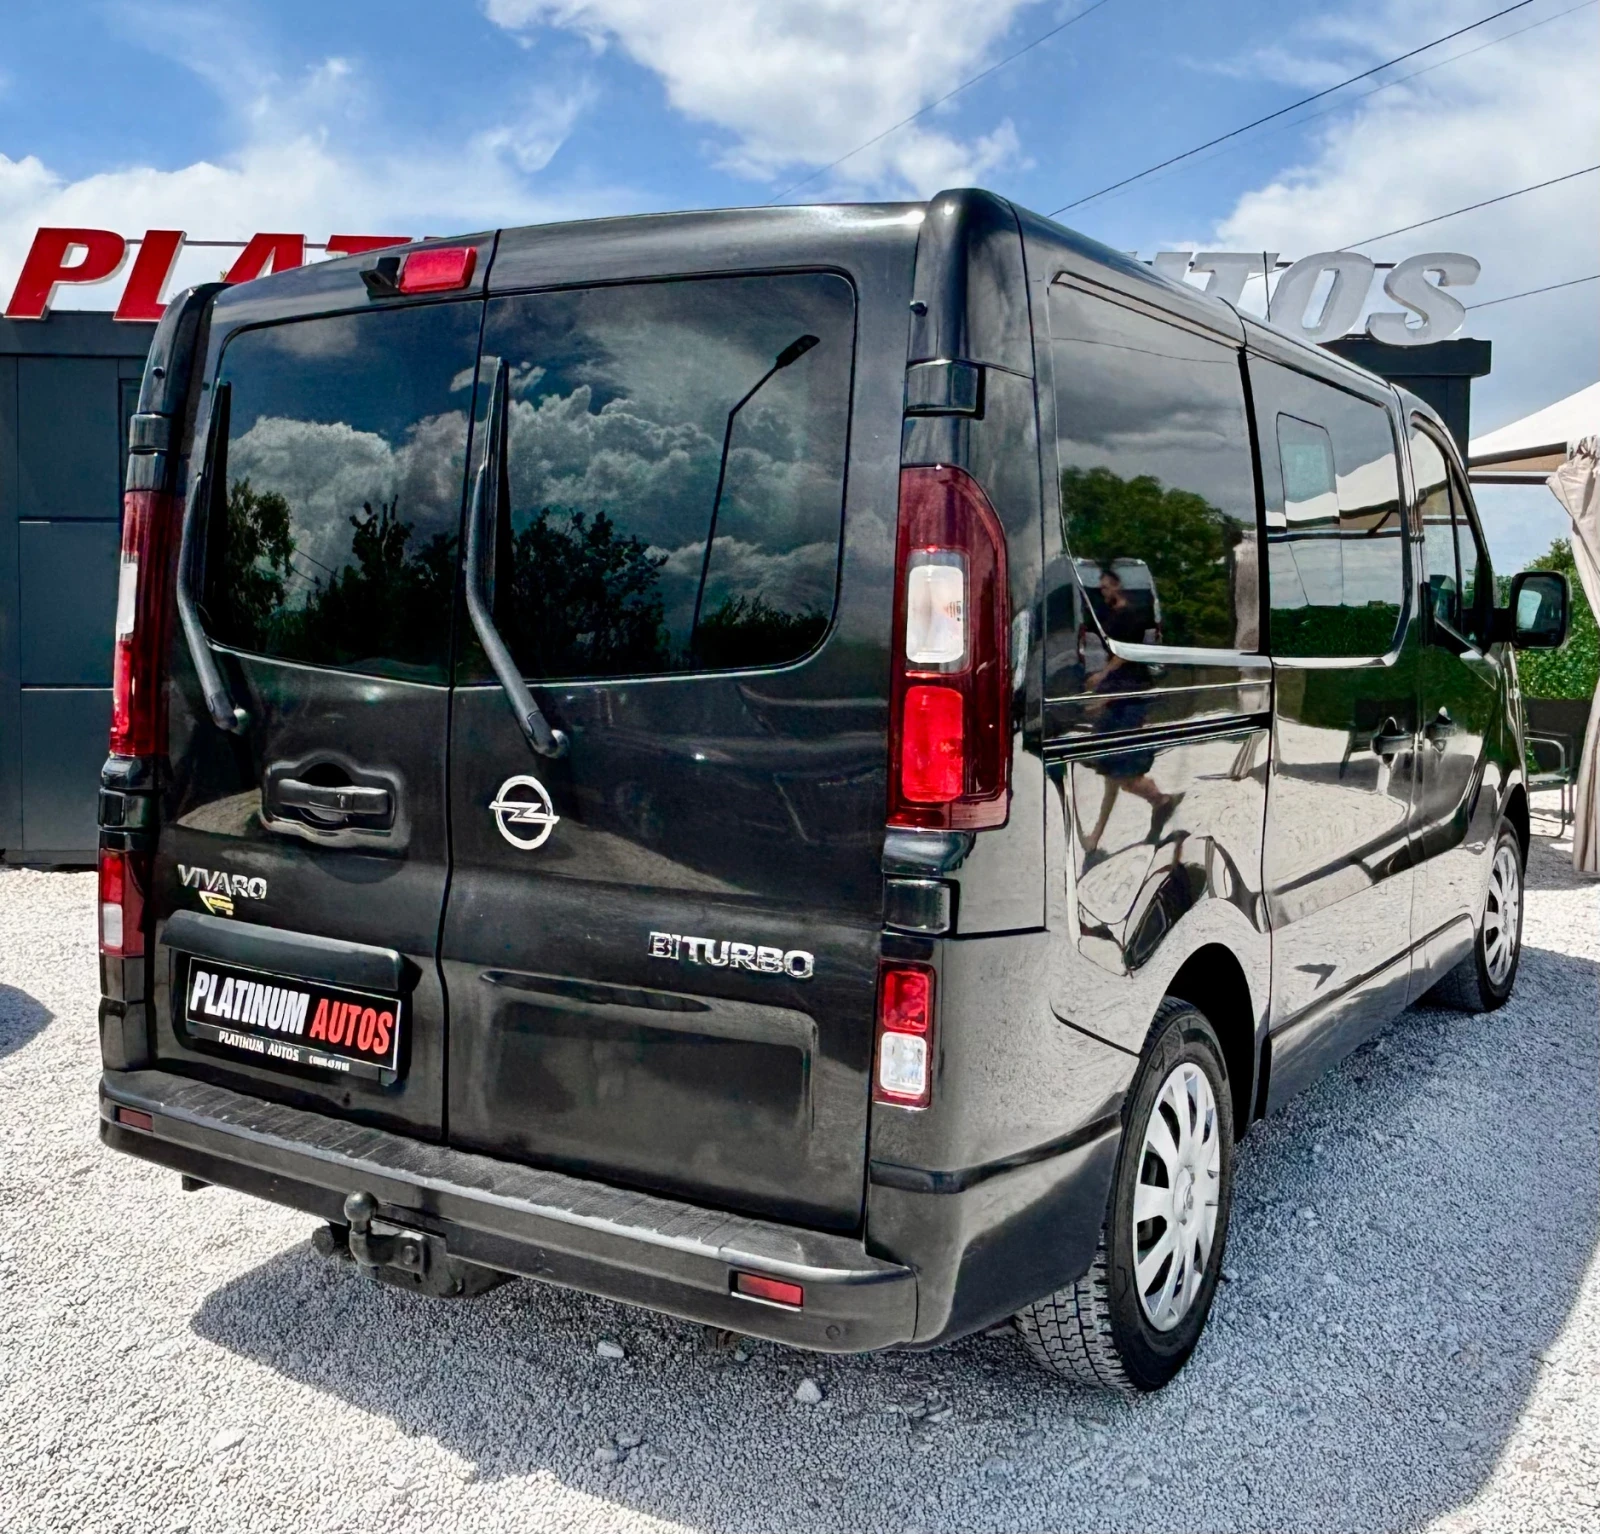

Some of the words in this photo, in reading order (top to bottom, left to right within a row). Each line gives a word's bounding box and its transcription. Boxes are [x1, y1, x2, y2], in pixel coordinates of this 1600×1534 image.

[4, 228, 414, 322] PLA
[177, 864, 267, 899] VIVARO
[647, 931, 815, 979] BITURBO
[190, 971, 310, 1035] PLATINUM
[309, 999, 393, 1055] AUTOS
[218, 1031, 265, 1054] PLATINUM
[268, 1043, 300, 1061] AUTOS
